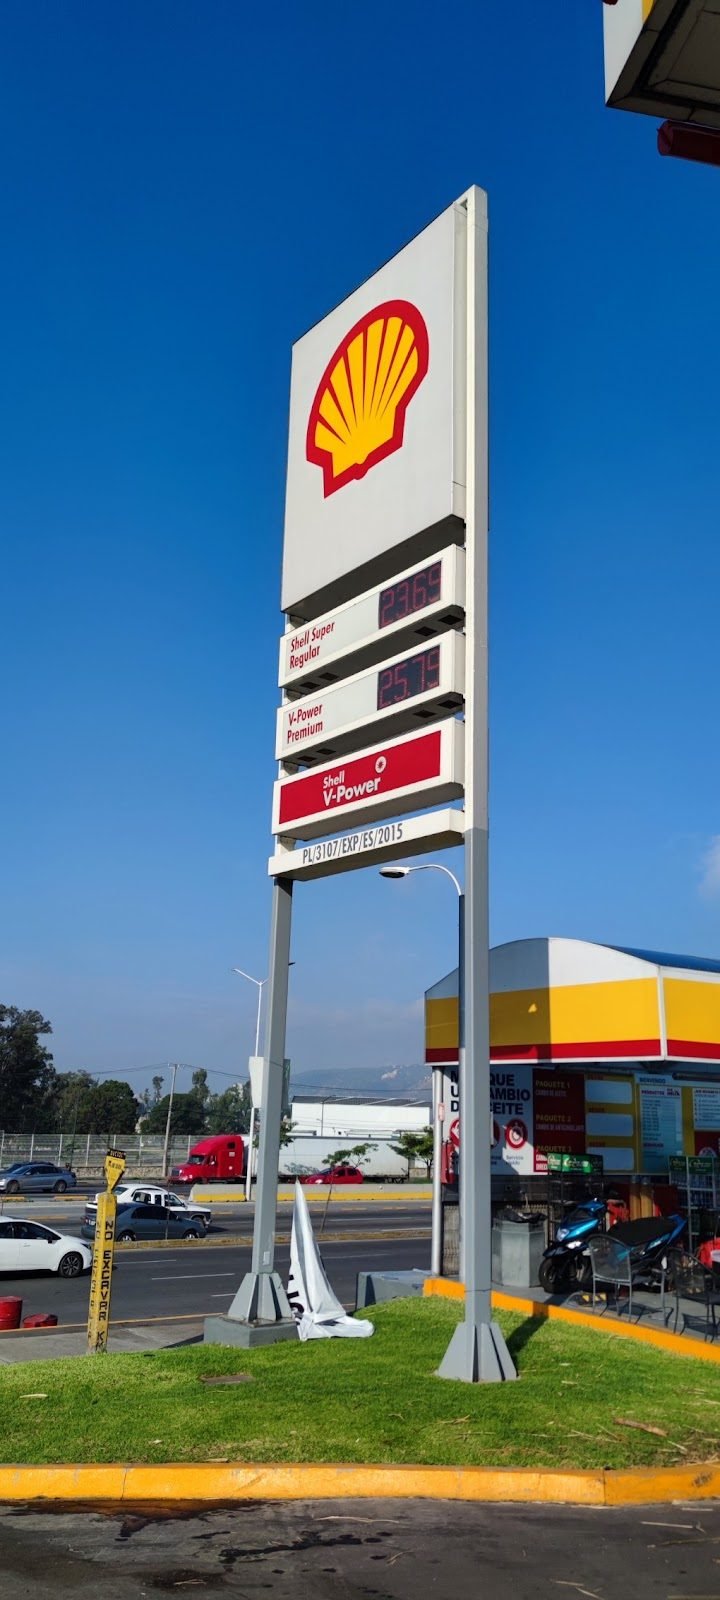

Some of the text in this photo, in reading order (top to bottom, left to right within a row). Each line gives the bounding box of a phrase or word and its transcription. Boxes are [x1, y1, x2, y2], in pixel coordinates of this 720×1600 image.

[290, 620, 336, 653] Shell Super
[289, 645, 321, 670] Regular
[288, 703, 323, 726] V-Power
[287, 720, 324, 744] Premium
[323, 771, 345, 789] Shell
[323, 776, 381, 807] V-Power
[302, 823, 403, 865] PL/3107/EXP/ES/2015
[490, 1089, 531, 1101] AMBIO
[490, 1102, 524, 1115] EITE
[104, 1220, 114, 1241] NO
[98, 1250, 112, 1321] EXCAVAR
